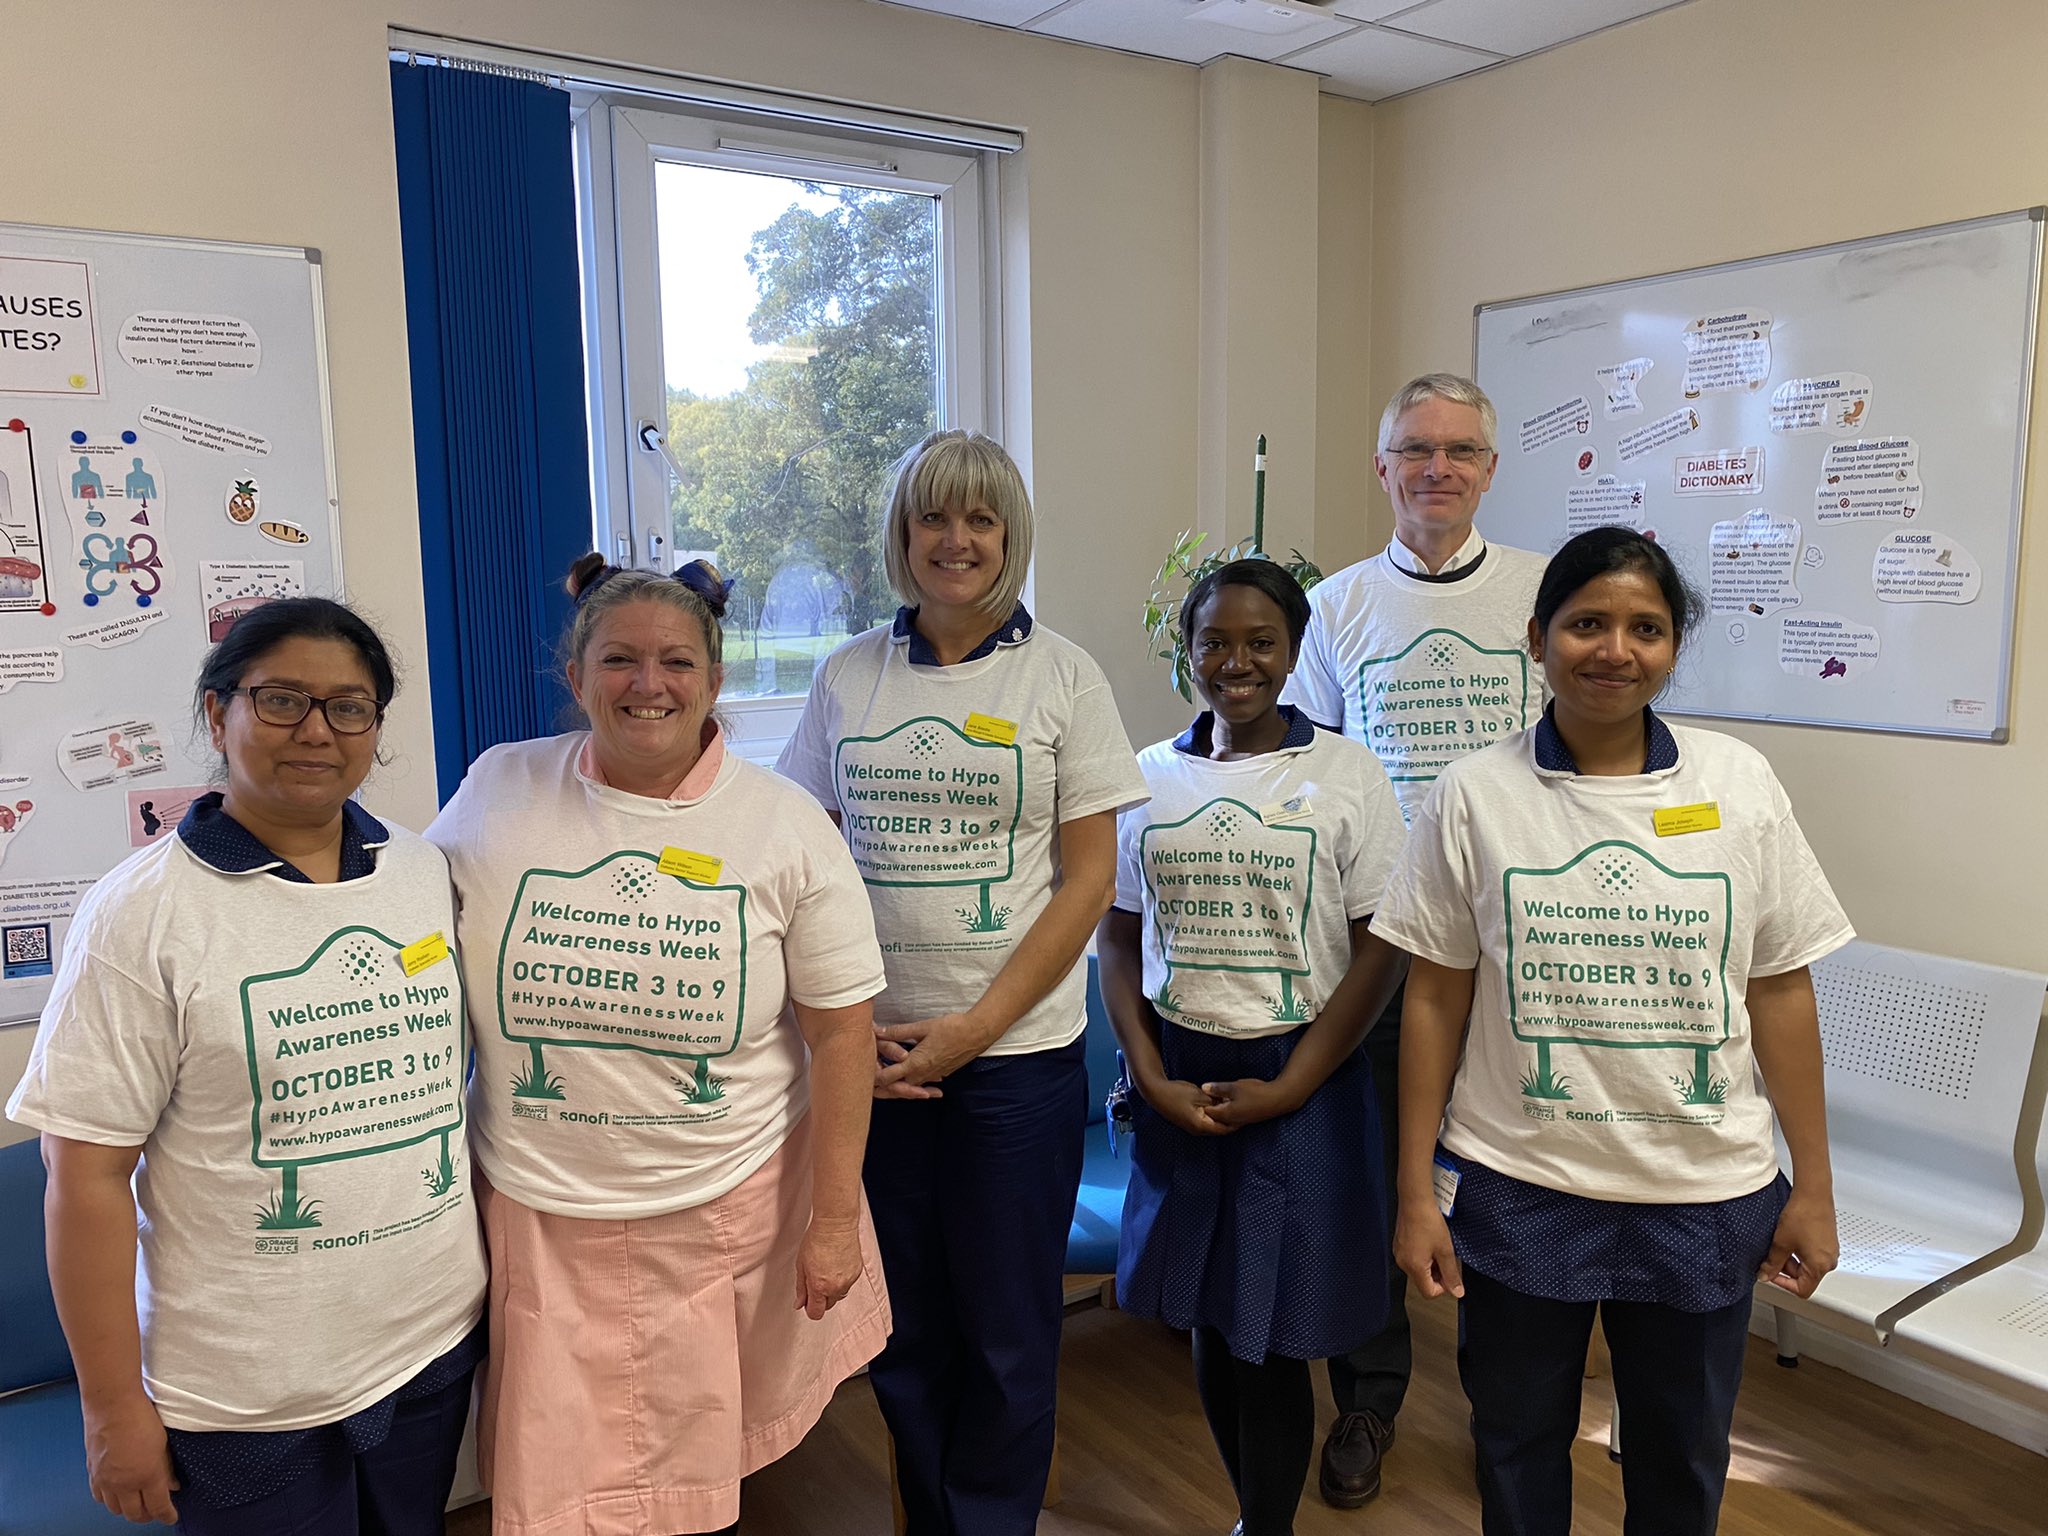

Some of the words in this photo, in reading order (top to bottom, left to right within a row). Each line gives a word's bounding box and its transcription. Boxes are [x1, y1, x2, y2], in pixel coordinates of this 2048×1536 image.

[0, 329, 61, 350] TES?
[188, 417, 202, 426] have
[204, 423, 225, 433] enough
[1688, 459, 1746, 472] DIABETES
[1680, 473, 1753, 488] DICTIONARY
[1895, 535, 1932, 543] GLUCOSE
[68, 632, 87, 641] These
[101, 623, 119, 633] called
[119, 614, 151, 627] INSULIN
[152, 611, 163, 619] and
[101, 627, 139, 643] GLUCAGON
[3, 671, 45, 679] consumption
[13, 661, 45, 669] according
[1374, 678, 1445, 694] Welcome
[1450, 676, 1465, 688] to
[1470, 675, 1509, 690] Hypo
[1376, 696, 1463, 712] Awareness
[1467, 693, 1509, 706] Week
[1374, 720, 1457, 739] OCTOBER
[1465, 720, 1474, 733] 3
[1481, 720, 1497, 732] to
[1504, 717, 1513, 731] 9
[844, 764, 922, 780] Welcome
[928, 767, 945, 782] to
[952, 768, 1000, 787] Hypo
[847, 786, 941, 803] Awareness
[947, 790, 999, 806] Week
[850, 814, 932, 834] OCTOBER
[939, 818, 951, 834] 3
[960, 819, 980, 835] to
[989, 819, 1000, 833] 9
[1151, 850, 1222, 866] Welcome
[1228, 850, 1245, 864] to
[1250, 849, 1295, 869] Hypo
[1156, 872, 1241, 886] Awareness
[1246, 872, 1292, 891] Week
[3, 892, 39, 900] DIABETES
[530, 900, 630, 927] Welcome
[638, 912, 658, 930] to
[665, 915, 721, 936] Hypo
[1158, 899, 1233, 918] OCTOBER
[1242, 902, 1253, 918] 3
[1260, 904, 1278, 921] to
[1286, 906, 1294, 923] 9
[1523, 900, 1620, 920] Welcome
[1627, 904, 1649, 922] to
[1655, 905, 1710, 926] Hypo
[522, 926, 651, 956] Awareness
[659, 939, 721, 961] Week
[1525, 927, 1644, 948] Awareness
[1650, 931, 1707, 950] Week
[512, 961, 639, 992] OCTOBER
[650, 975, 666, 996] 3
[676, 979, 702, 999] to
[712, 979, 726, 1000] 9
[1521, 962, 1636, 985] OCTOBER
[1645, 966, 1659, 986] 3
[1668, 969, 1692, 987] to
[1702, 969, 1712, 988] 9
[268, 996, 374, 1029] Welcome
[379, 991, 401, 1010] to
[404, 984, 450, 1010] Hypo
[511, 991, 725, 1023] #HypoAwarenessWeek
[1521, 991, 1715, 1011] #HypoAwarenessWeek
[513, 1016, 721, 1044] www.hypoawarenessweek.com
[1181, 1015, 1216, 1031] sanofi
[1523, 1014, 1715, 1033] www.hypoawarenessweek.com
[275, 1020, 400, 1060] Awareness
[404, 1009, 453, 1034] Week
[271, 1058, 395, 1102] OCTOBER
[403, 1054, 416, 1076] 3
[422, 1050, 441, 1072] to
[445, 1045, 453, 1065] 9
[269, 1101, 454, 1147] www.hypoawarenessweekcom
[559, 1111, 608, 1125] sanofi
[1566, 1110, 1613, 1122] sanofi
[313, 1230, 369, 1250] sanofi
